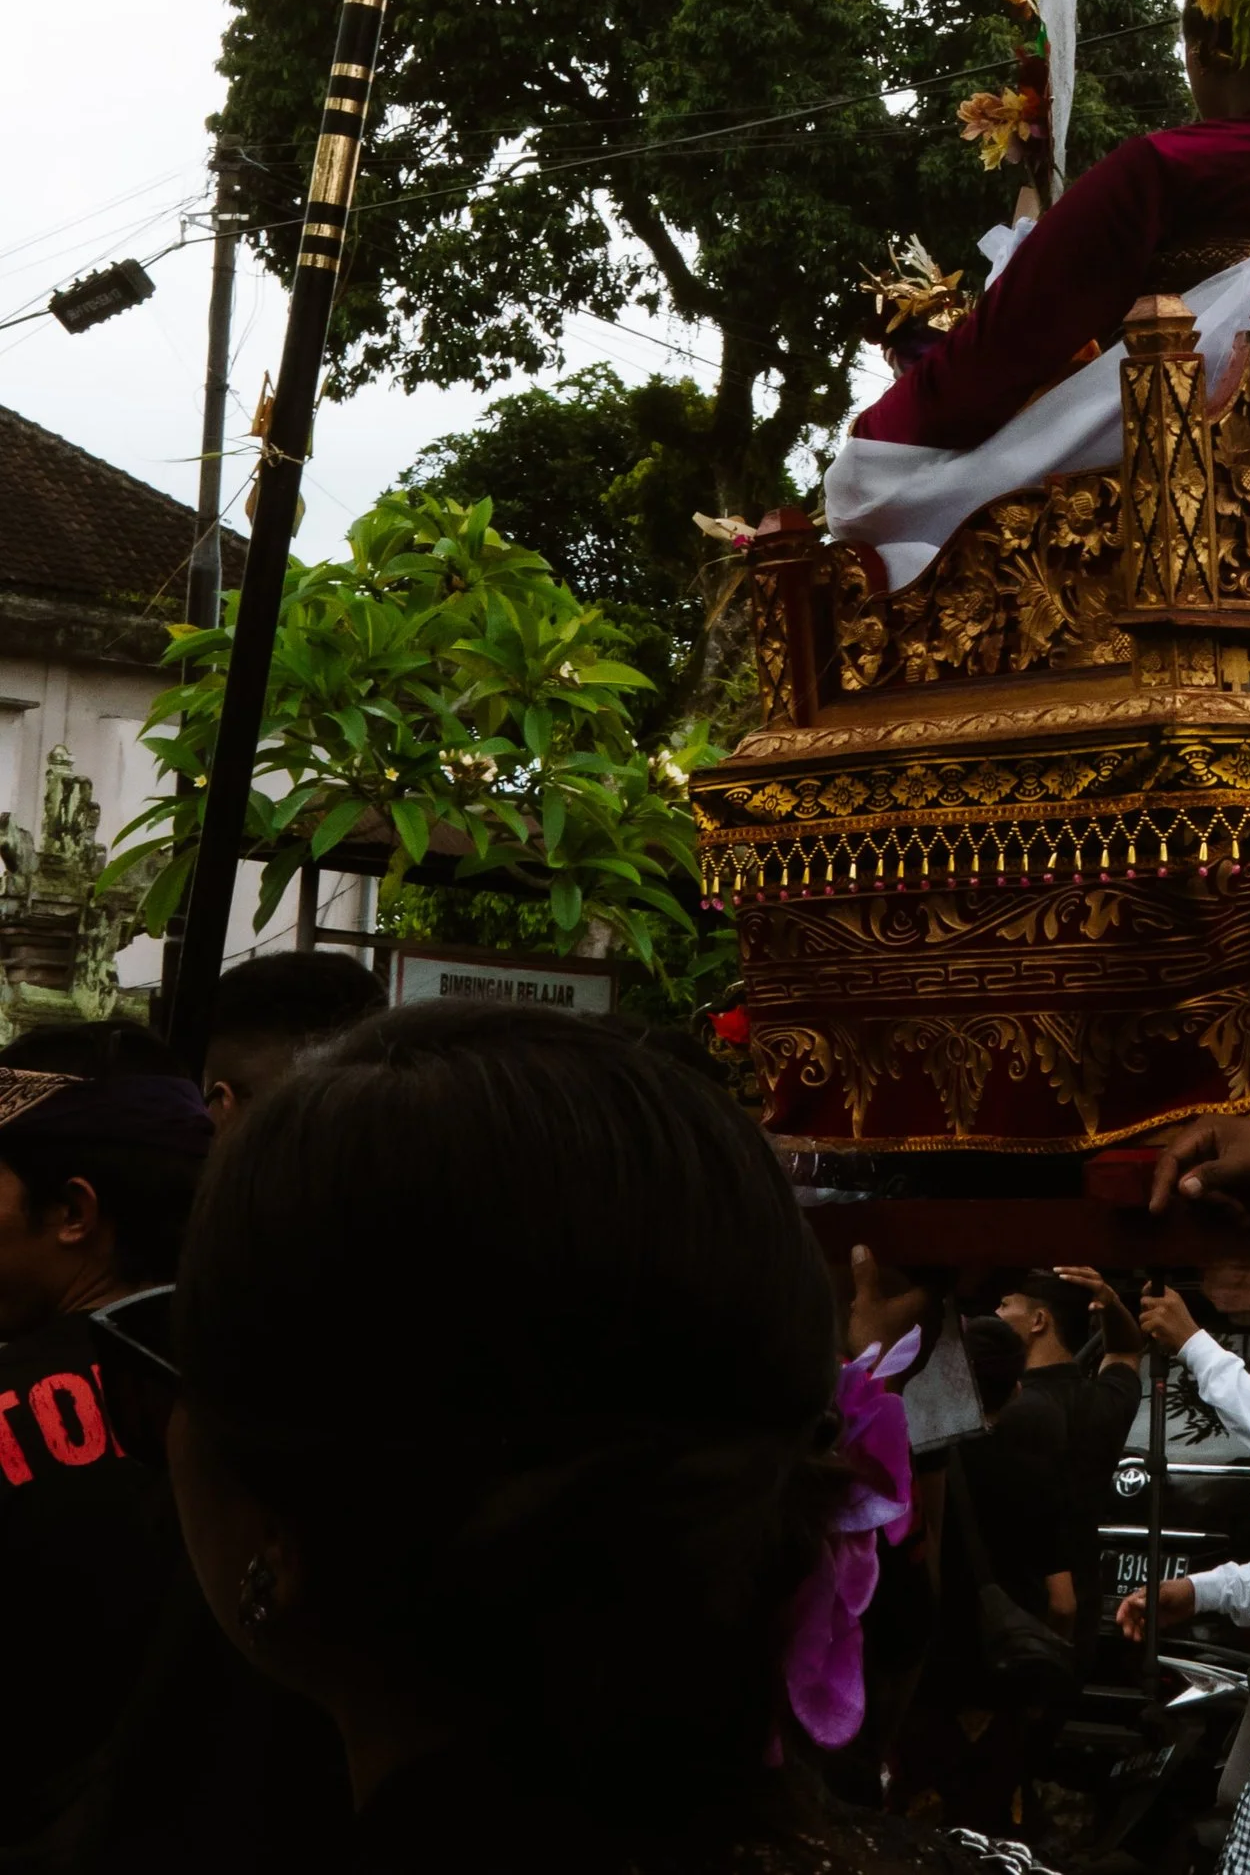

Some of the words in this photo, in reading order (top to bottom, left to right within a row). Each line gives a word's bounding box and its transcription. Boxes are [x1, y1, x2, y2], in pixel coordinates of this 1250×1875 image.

[439, 972, 513, 1003] BIMBINGAN
[517, 981, 575, 1008] BELAJAR
[0, 1361, 127, 1487] TO
